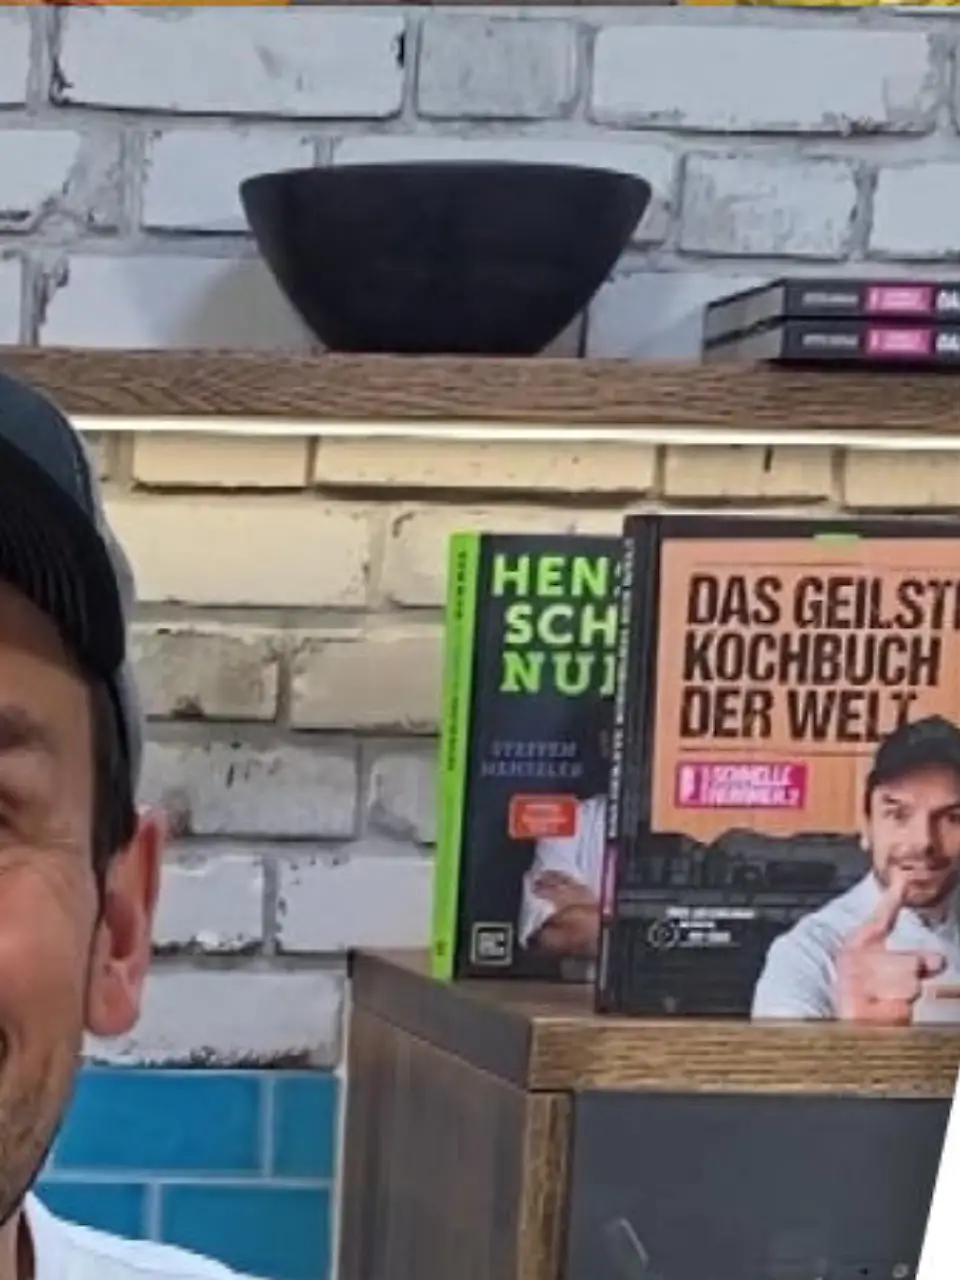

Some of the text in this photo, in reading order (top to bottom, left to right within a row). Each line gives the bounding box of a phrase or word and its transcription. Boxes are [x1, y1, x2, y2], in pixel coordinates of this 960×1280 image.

[492, 553, 622, 597] HEN
[688, 574, 783, 627] DAS
[683, 633, 942, 687] KOCHBUCH
[680, 688, 917, 743] DER WELT
